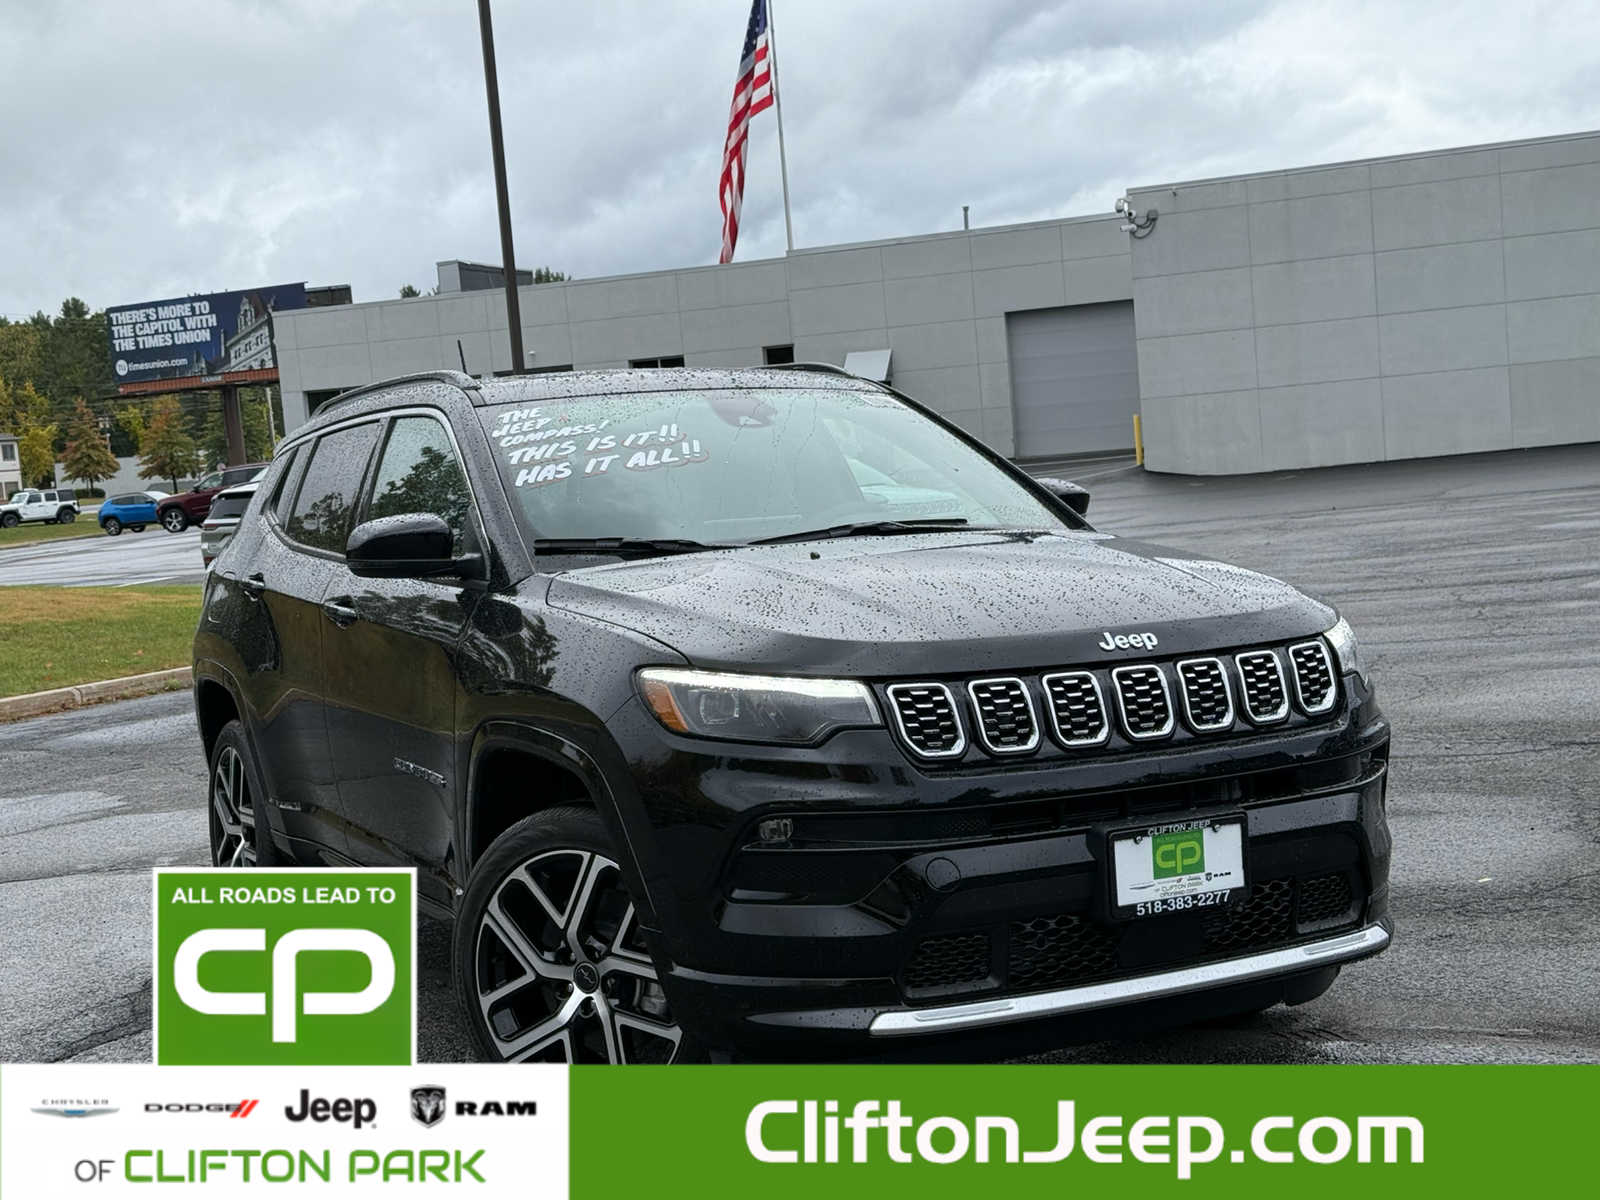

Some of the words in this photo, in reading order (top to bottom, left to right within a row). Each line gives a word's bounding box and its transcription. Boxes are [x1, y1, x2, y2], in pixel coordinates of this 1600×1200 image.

[110, 308, 157, 326] THERE'S
[158, 303, 191, 320] MORE
[193, 301, 210, 315] TO
[112, 324, 135, 340] THE
[135, 318, 184, 336] CAPITOL
[184, 314, 217, 330] WITH
[113, 337, 136, 352] THE
[137, 333, 173, 349] TIMES
[174, 329, 211, 345] UNION
[492, 417, 552, 437] JEEP
[498, 407, 542, 424] THE
[499, 420, 610, 448] COMPASS!
[507, 440, 577, 465] THIS
[585, 435, 617, 451] IS
[515, 462, 572, 487] HAS
[584, 454, 620, 474] IT
[1099, 632, 1158, 650] Jeep
[1148, 823, 1187, 836] CLIFTON
[1188, 819, 1211, 831] JEEP
[1136, 889, 1231, 916] 518-383-2277
